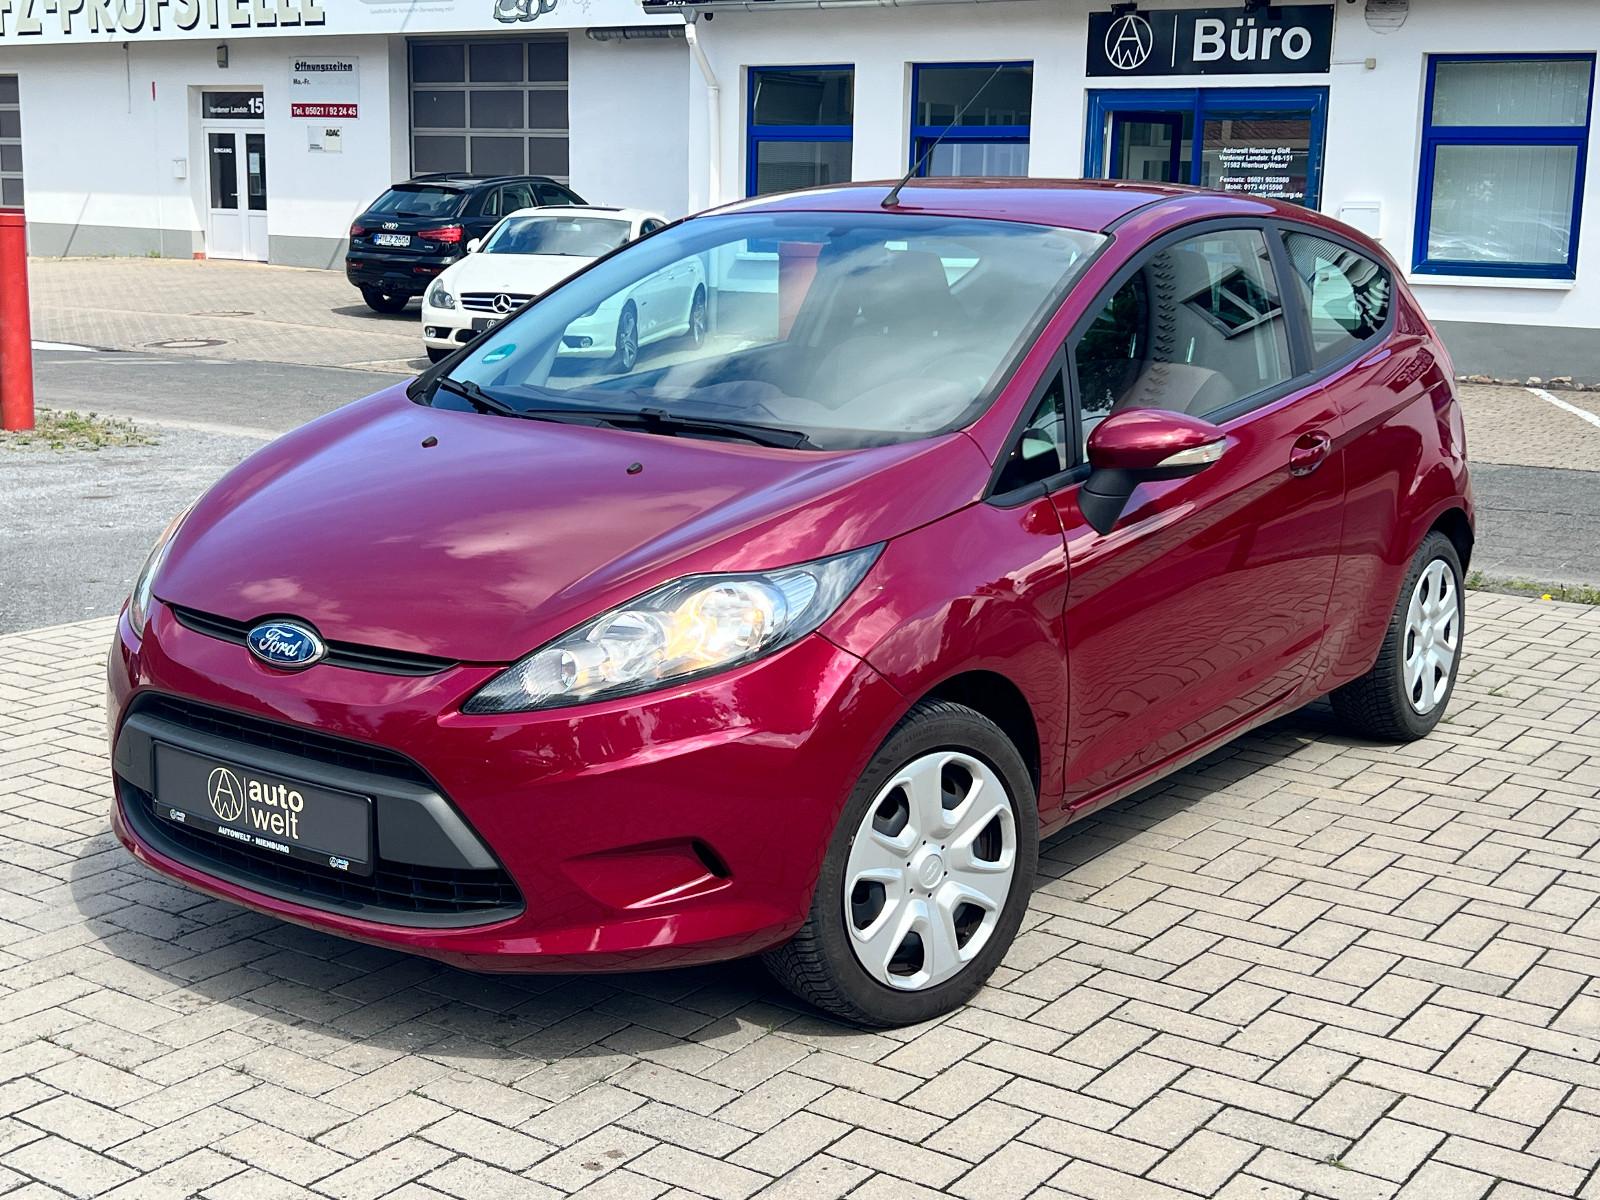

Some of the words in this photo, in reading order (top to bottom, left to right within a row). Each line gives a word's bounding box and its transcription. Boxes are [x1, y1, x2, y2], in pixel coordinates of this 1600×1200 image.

[1192, 18, 1312, 62] Büro
[294, 59, 353, 72] Öffnungszeiten
[248, 97, 264, 114] 15
[292, 106, 304, 116] Tel.
[305, 106, 324, 116] 05021
[329, 107, 337, 116] 92
[339, 107, 347, 116] 24
[348, 107, 357, 116] 45
[325, 129, 340, 137] ADAC
[258, 628, 302, 657] Ford
[248, 780, 304, 813] auto
[250, 807, 299, 839] welt
[218, 826, 251, 842] AUTOWELT
[255, 837, 290, 854] NIENBURG
